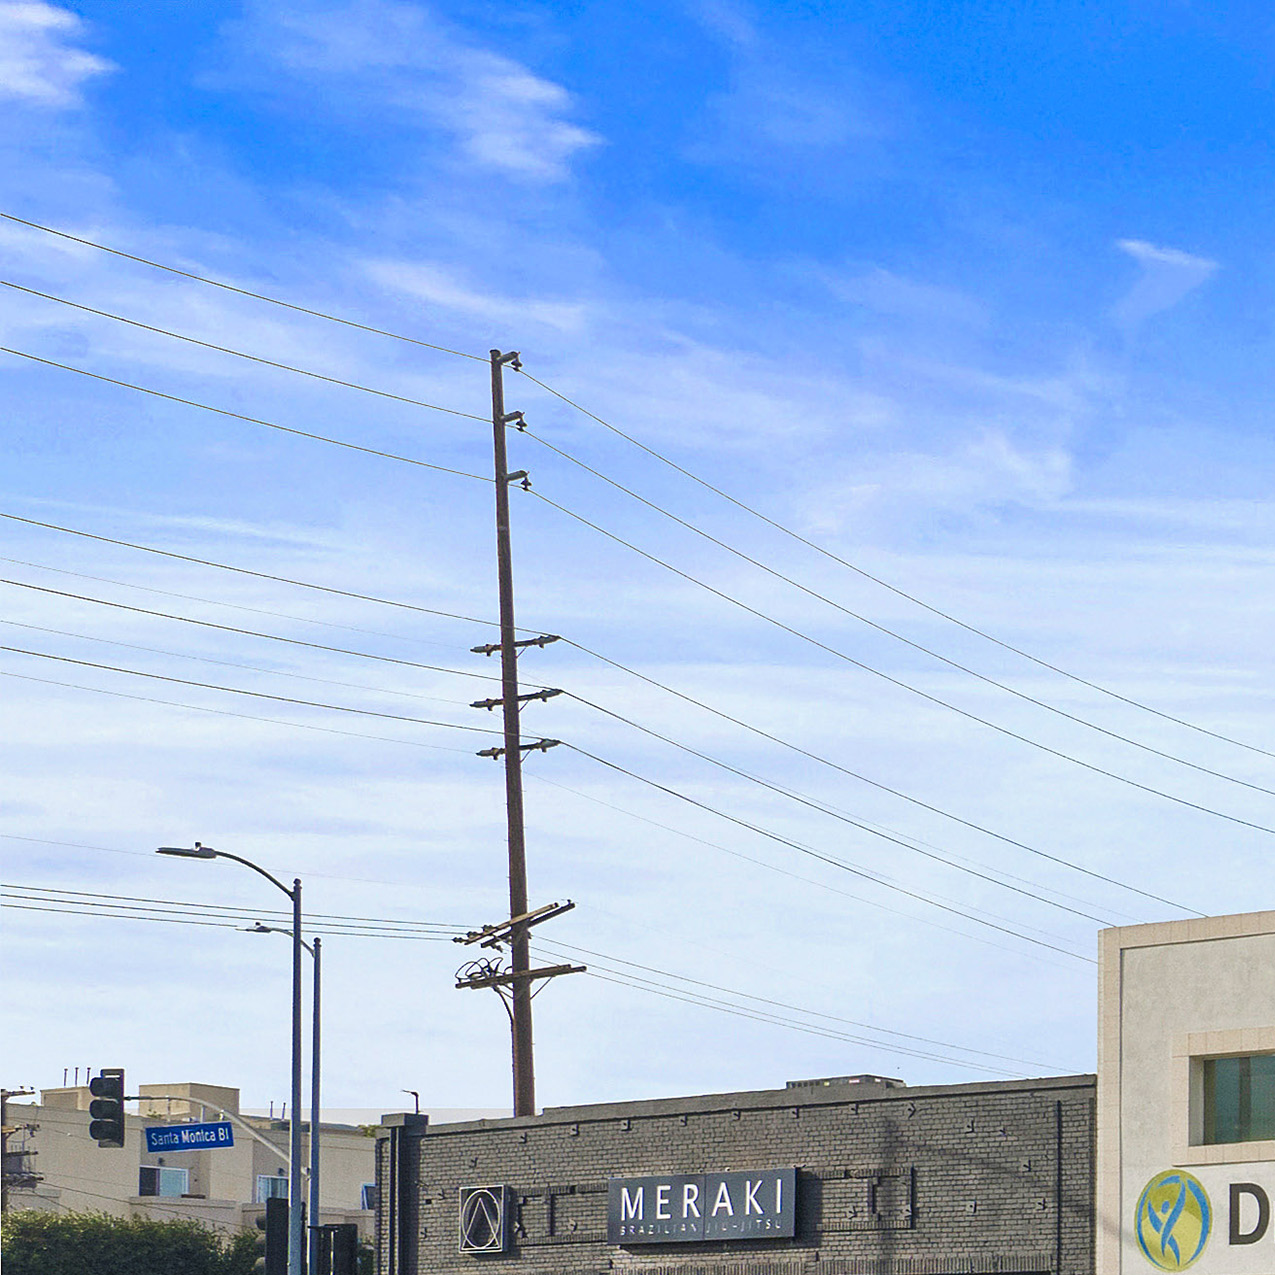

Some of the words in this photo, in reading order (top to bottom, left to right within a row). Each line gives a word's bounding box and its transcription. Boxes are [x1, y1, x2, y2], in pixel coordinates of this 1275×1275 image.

[151, 1132, 179, 1146] Santa
[181, 1129, 216, 1143] Monica
[218, 1127, 229, 1141] Bl
[620, 1178, 783, 1221] MERAKI
[620, 1223, 697, 1236] BRAZILIAN
[705, 1218, 782, 1234] JIU-JITSU
